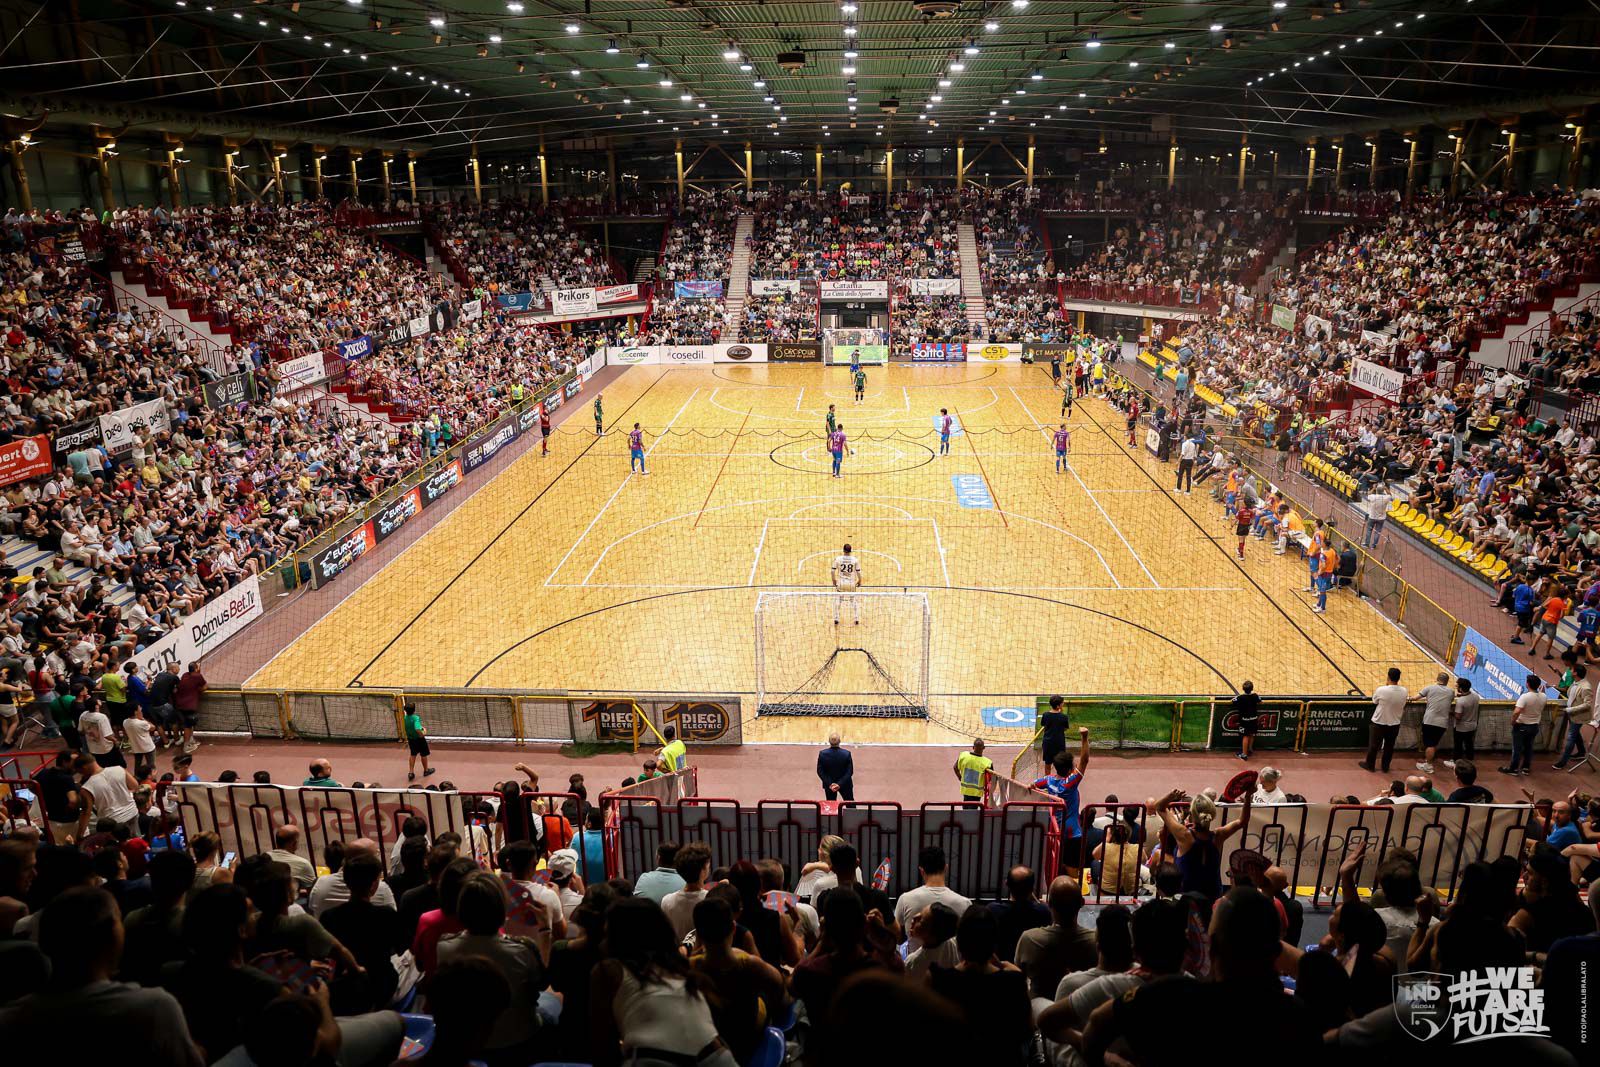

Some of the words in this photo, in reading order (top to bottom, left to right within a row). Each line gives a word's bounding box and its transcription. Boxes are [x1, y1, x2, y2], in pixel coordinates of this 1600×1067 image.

[558, 290, 590, 302] PriKors
[671, 350, 704, 360] cosedil
[985, 346, 1006, 354] CST
[1359, 366, 1372, 385] Città
[1372, 371, 1379, 387] di
[227, 374, 243, 395] celi
[332, 530, 367, 560] EUROCAR
[840, 563, 854, 573] 28
[1586, 615, 1596, 625] 17
[1484, 660, 1500, 679] META
[1498, 671, 1523, 696] CATANIA
[681, 713, 722, 723] DIECI
